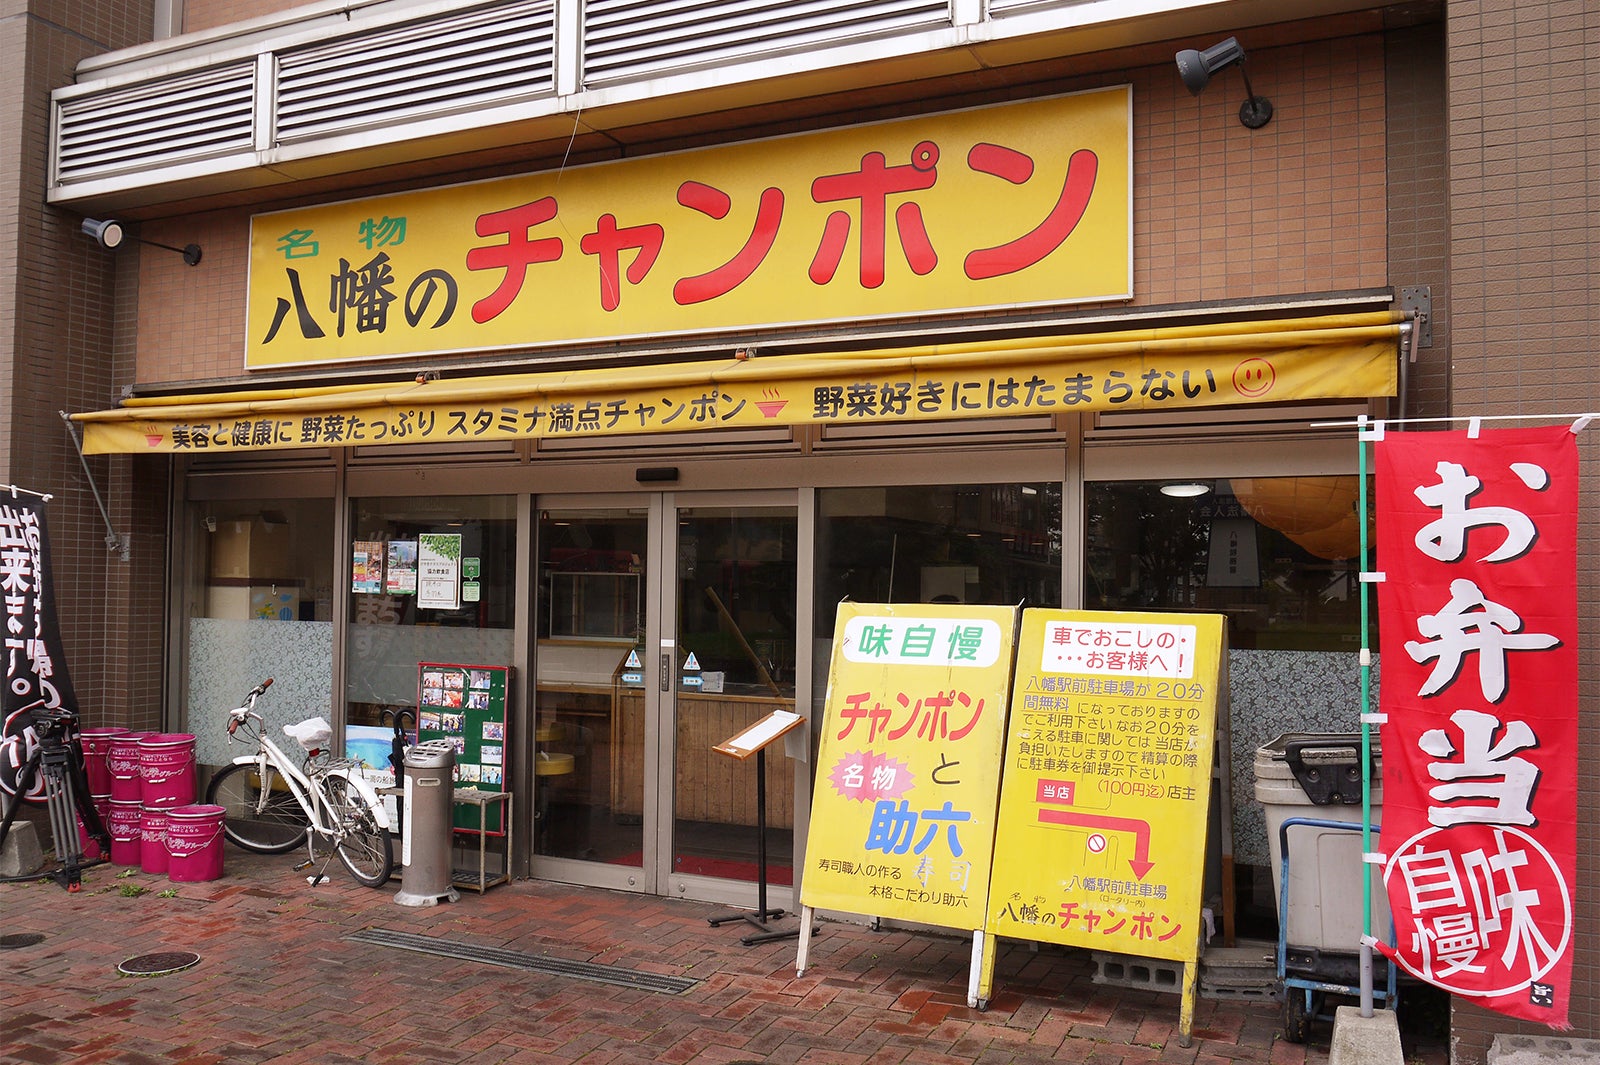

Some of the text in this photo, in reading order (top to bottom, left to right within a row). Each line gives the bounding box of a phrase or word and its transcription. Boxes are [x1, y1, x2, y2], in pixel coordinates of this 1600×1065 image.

[276, 215, 407, 259] 名物
[171, 368, 1218, 449] 美容と健康に 野菜たっぷり スタミナ満点チャンポン 野菜好きにはたまらない
[858, 624, 984, 660] 味自慢
[1403, 461, 1562, 827] お弁当
[837, 690, 985, 743] チャンポン
[842, 763, 897, 790] 名物
[931, 753, 961, 785] と
[1043, 785, 1070, 799] 当店
[865, 800, 971, 857] 助六
[818, 858, 902, 880] 寿司職人の作る
[912, 855, 972, 892] 寿司
[869, 885, 969, 908] 本格こだわり助六
